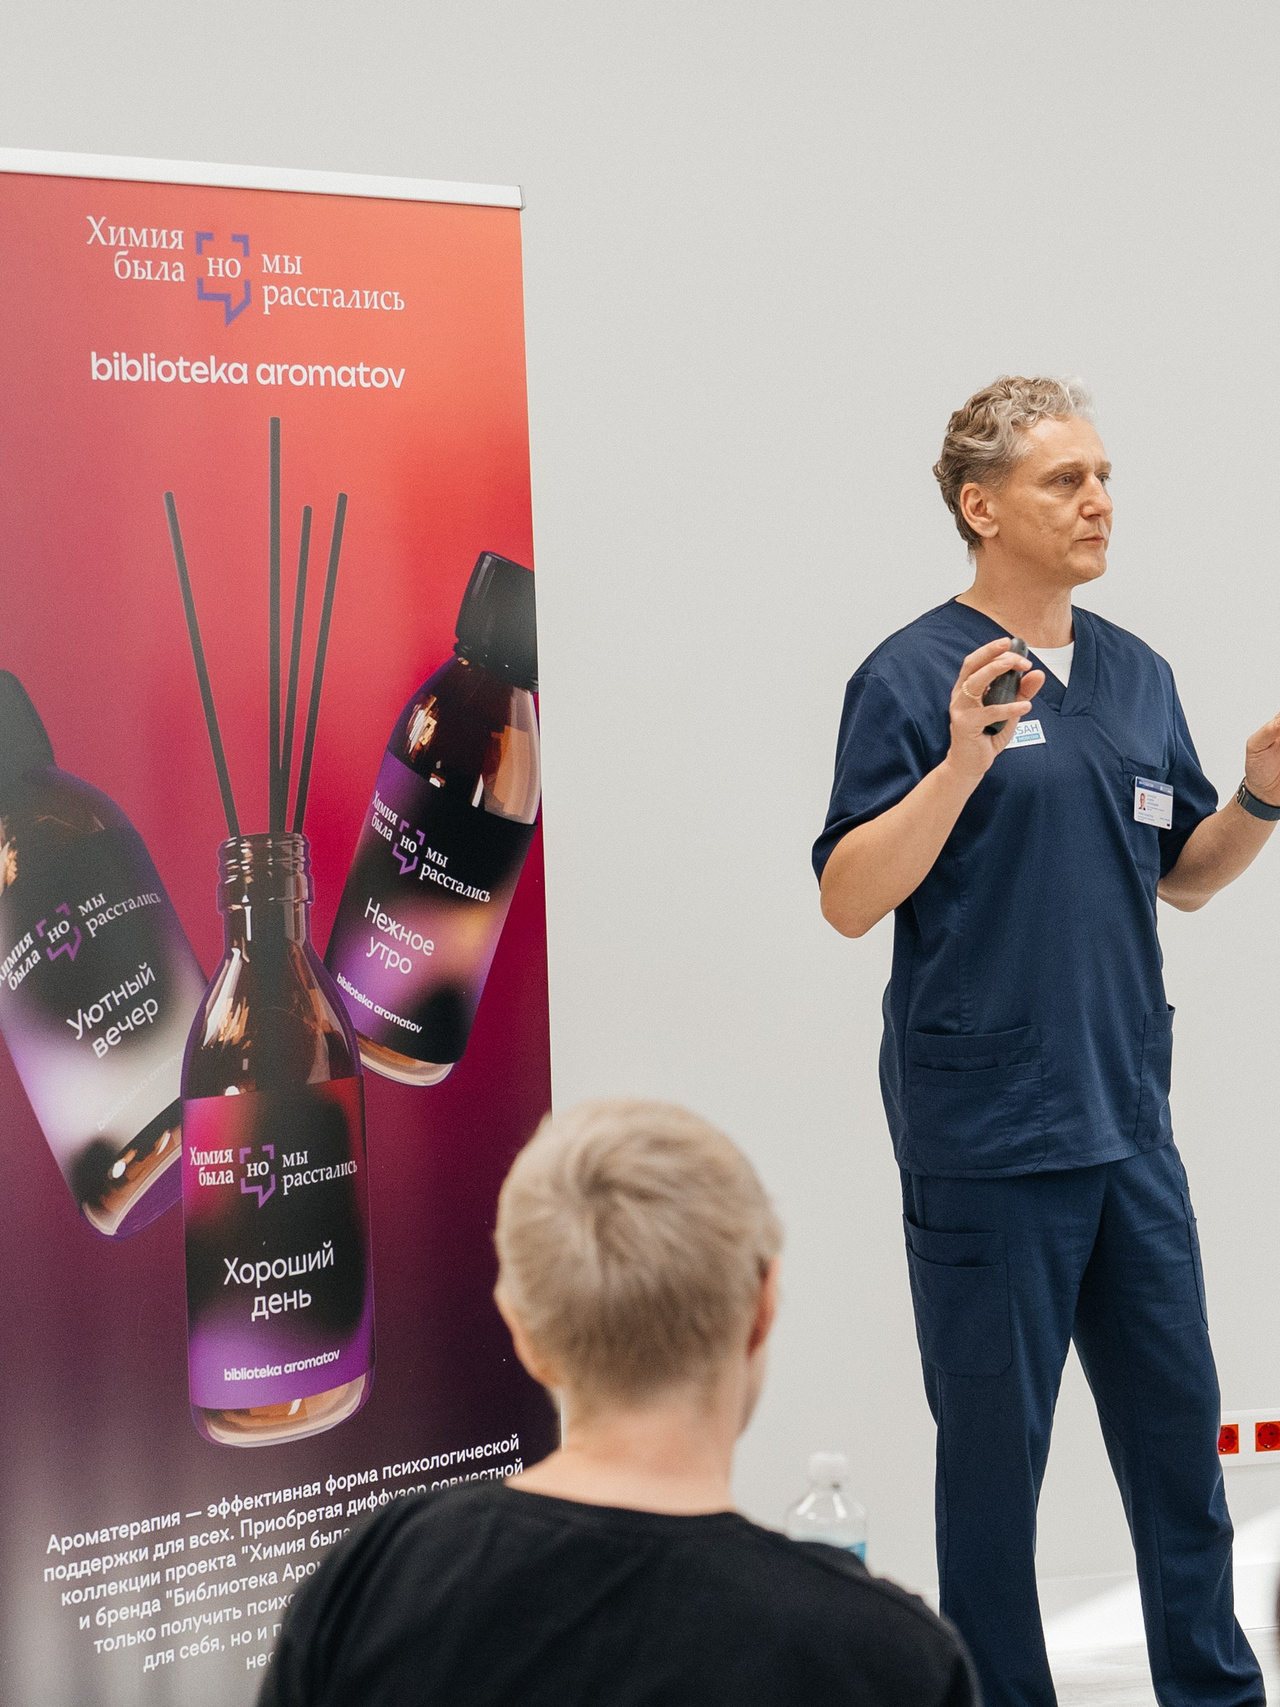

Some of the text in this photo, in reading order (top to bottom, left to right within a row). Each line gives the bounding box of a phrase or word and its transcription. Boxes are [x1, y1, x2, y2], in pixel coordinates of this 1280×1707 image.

[87, 215, 185, 250] Химия
[113, 250, 186, 281] была
[207, 253, 241, 279] но
[262, 253, 302, 275] мы
[263, 281, 405, 315] расстались
[90, 351, 405, 389] biblioteka aromatov
[371, 790, 399, 826] Химия
[371, 811, 394, 842] была
[400, 834, 417, 853] но
[425, 847, 449, 868] мы
[419, 863, 491, 903] расстались
[78, 893, 107, 917] мы
[47, 920, 70, 944] но
[364, 897, 435, 957] Нежное
[8, 949, 41, 991] была
[365, 936, 413, 975] утро
[66, 962, 156, 1040] Уютный
[336, 972, 423, 1034] biblioteka aromatov
[92, 998, 159, 1059] вечер
[189, 1146, 234, 1166] Химия
[246, 1161, 270, 1178] но
[282, 1150, 309, 1168] мы
[198, 1166, 234, 1187] была
[282, 1160, 358, 1195] расстались
[223, 1240, 334, 1289] Хороший
[251, 1289, 312, 1322] день
[224, 1349, 340, 1382] biblioteka aromatov
[46, 1511, 181, 1555] Ароматерапия
[207, 1479, 321, 1519] эффективная
[325, 1468, 378, 1496] форма
[382, 1433, 520, 1480] психологической
[43, 1546, 149, 1583] поддержки
[152, 1537, 184, 1561] для
[189, 1526, 235, 1550] всех.
[240, 1502, 343, 1539] Приобретая
[61, 1569, 161, 1606] коллекции
[165, 1553, 237, 1583] проекта
[242, 1538, 305, 1563] "Химия
[79, 1614, 90, 1630] и
[95, 1598, 161, 1628] бренда
[166, 1569, 278, 1608] "Библиотека
[93, 1626, 156, 1654] только
[161, 1605, 242, 1638] получить
[143, 1648, 175, 1673] для
[179, 1635, 225, 1660] себя,
[230, 1630, 252, 1647] но
[257, 1626, 267, 1640] и
